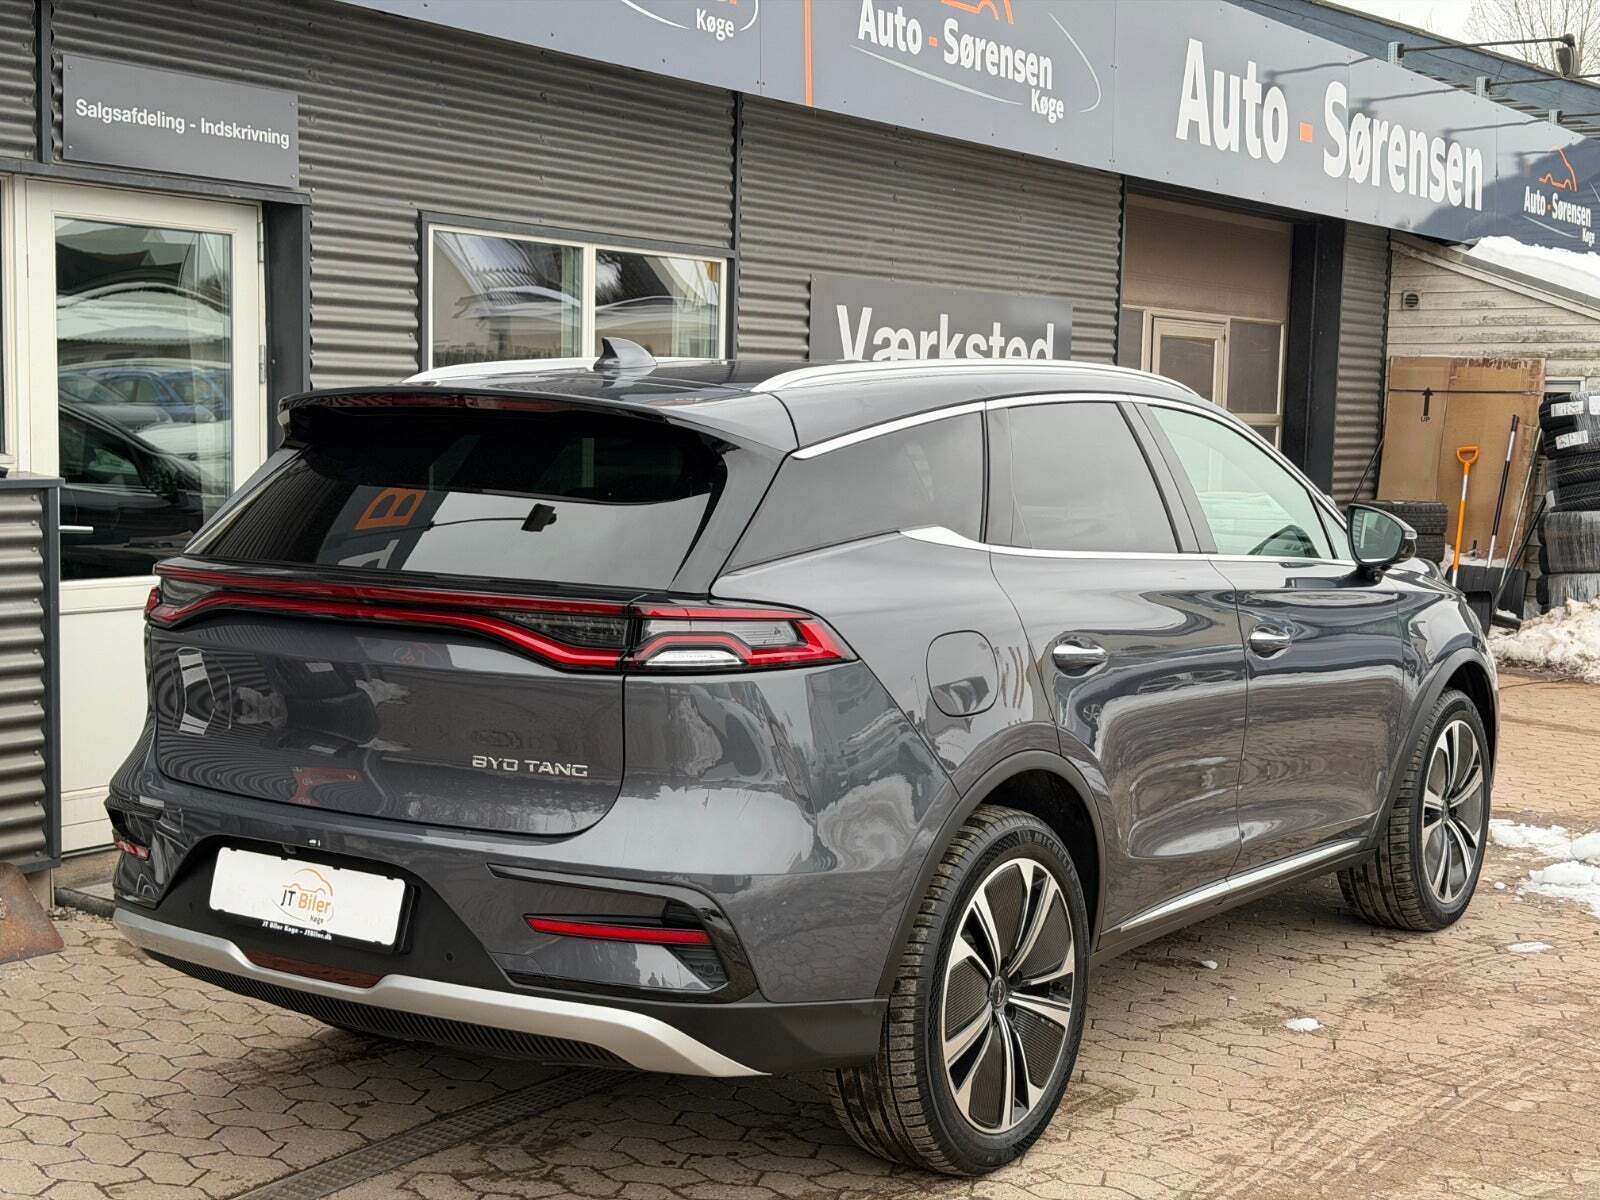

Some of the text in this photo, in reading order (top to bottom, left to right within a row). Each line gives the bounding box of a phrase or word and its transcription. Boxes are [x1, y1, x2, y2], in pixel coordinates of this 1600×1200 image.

[696, 8, 734, 41] Køge
[858, 0, 923, 55] Auto
[943, 18, 1053, 90] Sørensen
[75, 98, 185, 134] Salgsafdeling
[201, 117, 290, 149] Indskrivning
[1031, 88, 1064, 123] Køge
[1176, 38, 1289, 164] Auto
[1323, 81, 1483, 211] Sørensen
[1523, 185, 1546, 216] Auto
[1552, 192, 1592, 227] Sørensen
[524, 760, 589, 777] TANG
[280, 889, 331, 913] JT Biler
